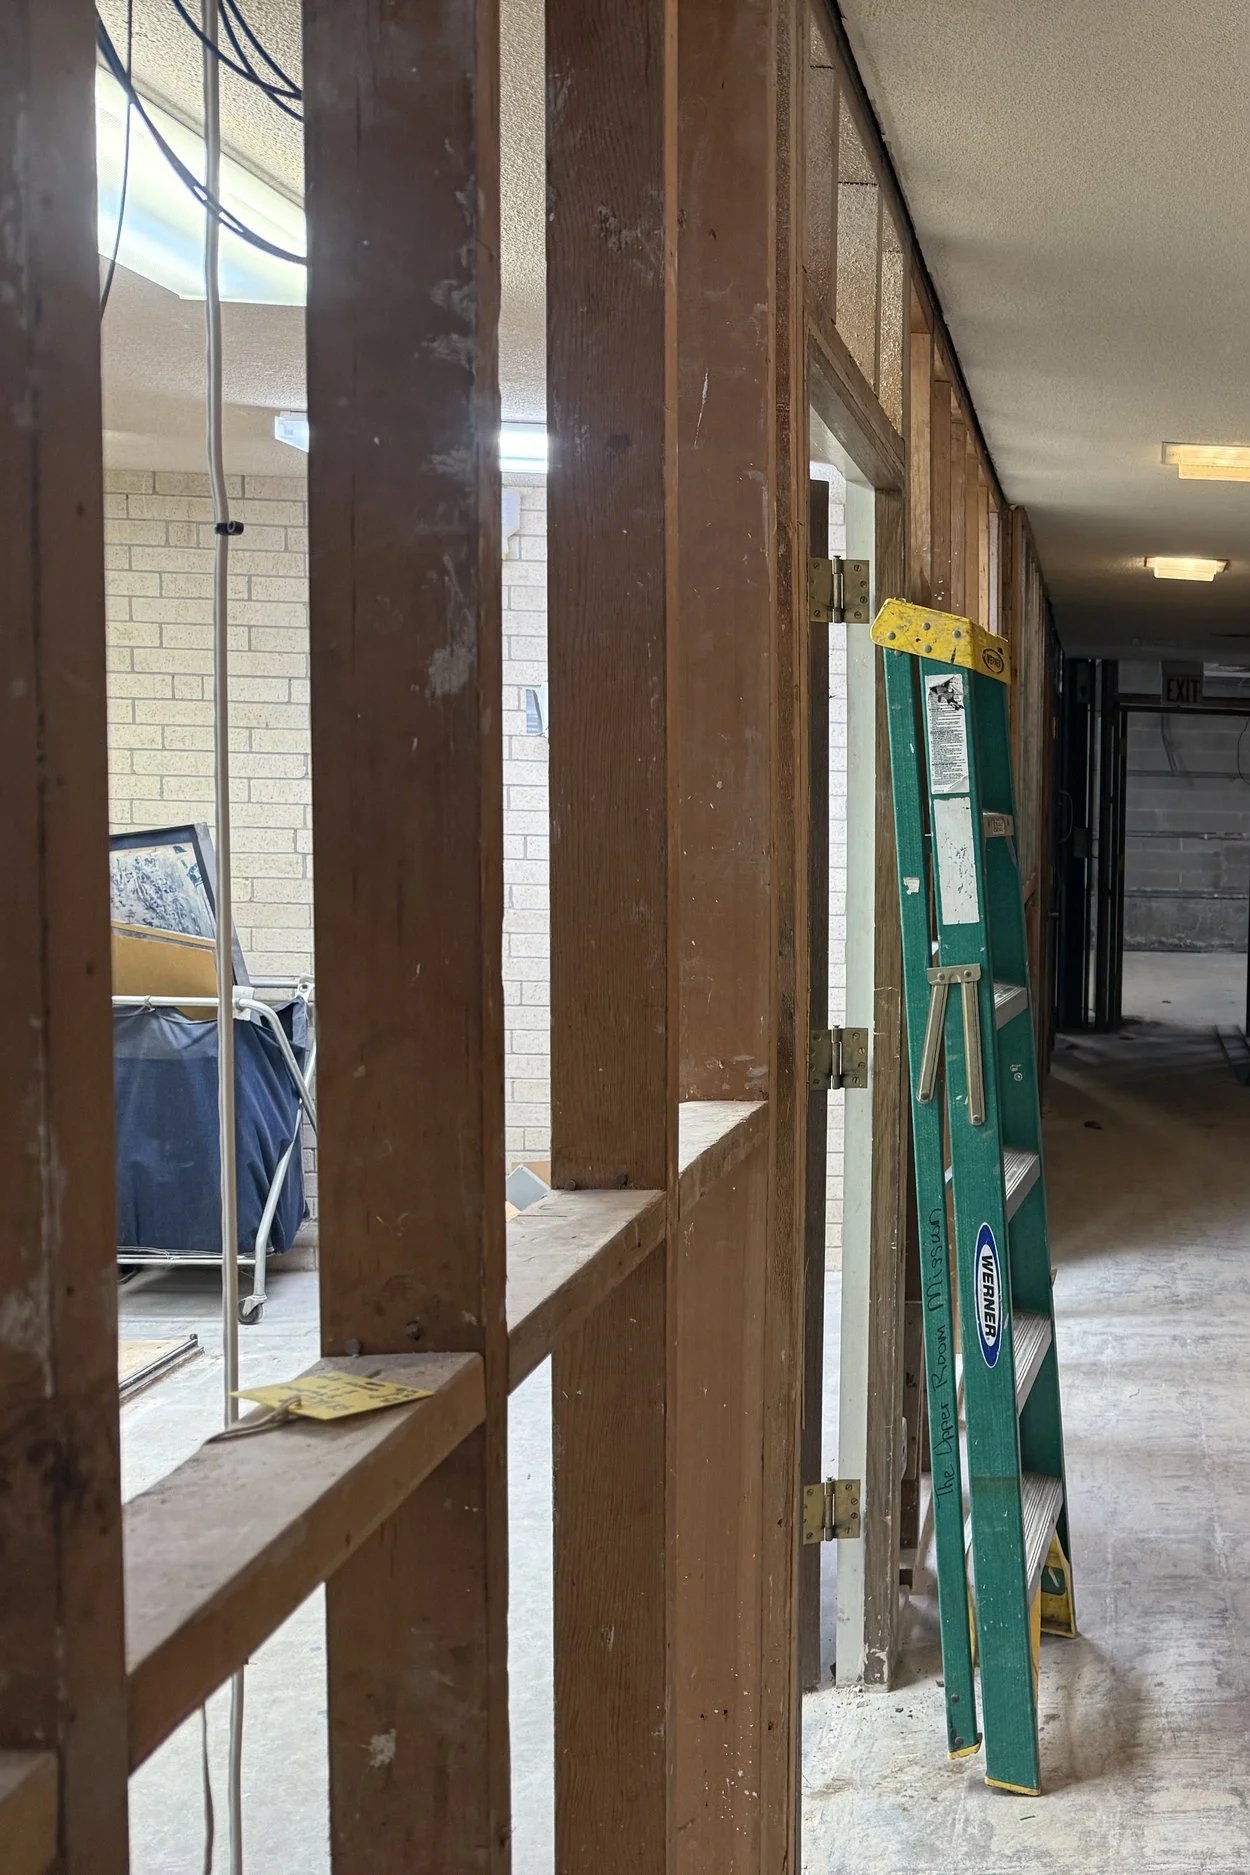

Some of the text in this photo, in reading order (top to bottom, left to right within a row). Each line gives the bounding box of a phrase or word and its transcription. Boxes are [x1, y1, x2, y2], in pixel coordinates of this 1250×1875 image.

[1166, 677, 1201, 704] EXIT
[981, 1255, 997, 1338] WERNER
[931, 1324, 948, 1391] Room
[932, 1402, 954, 1456] Upper
[934, 1464, 955, 1508] The
